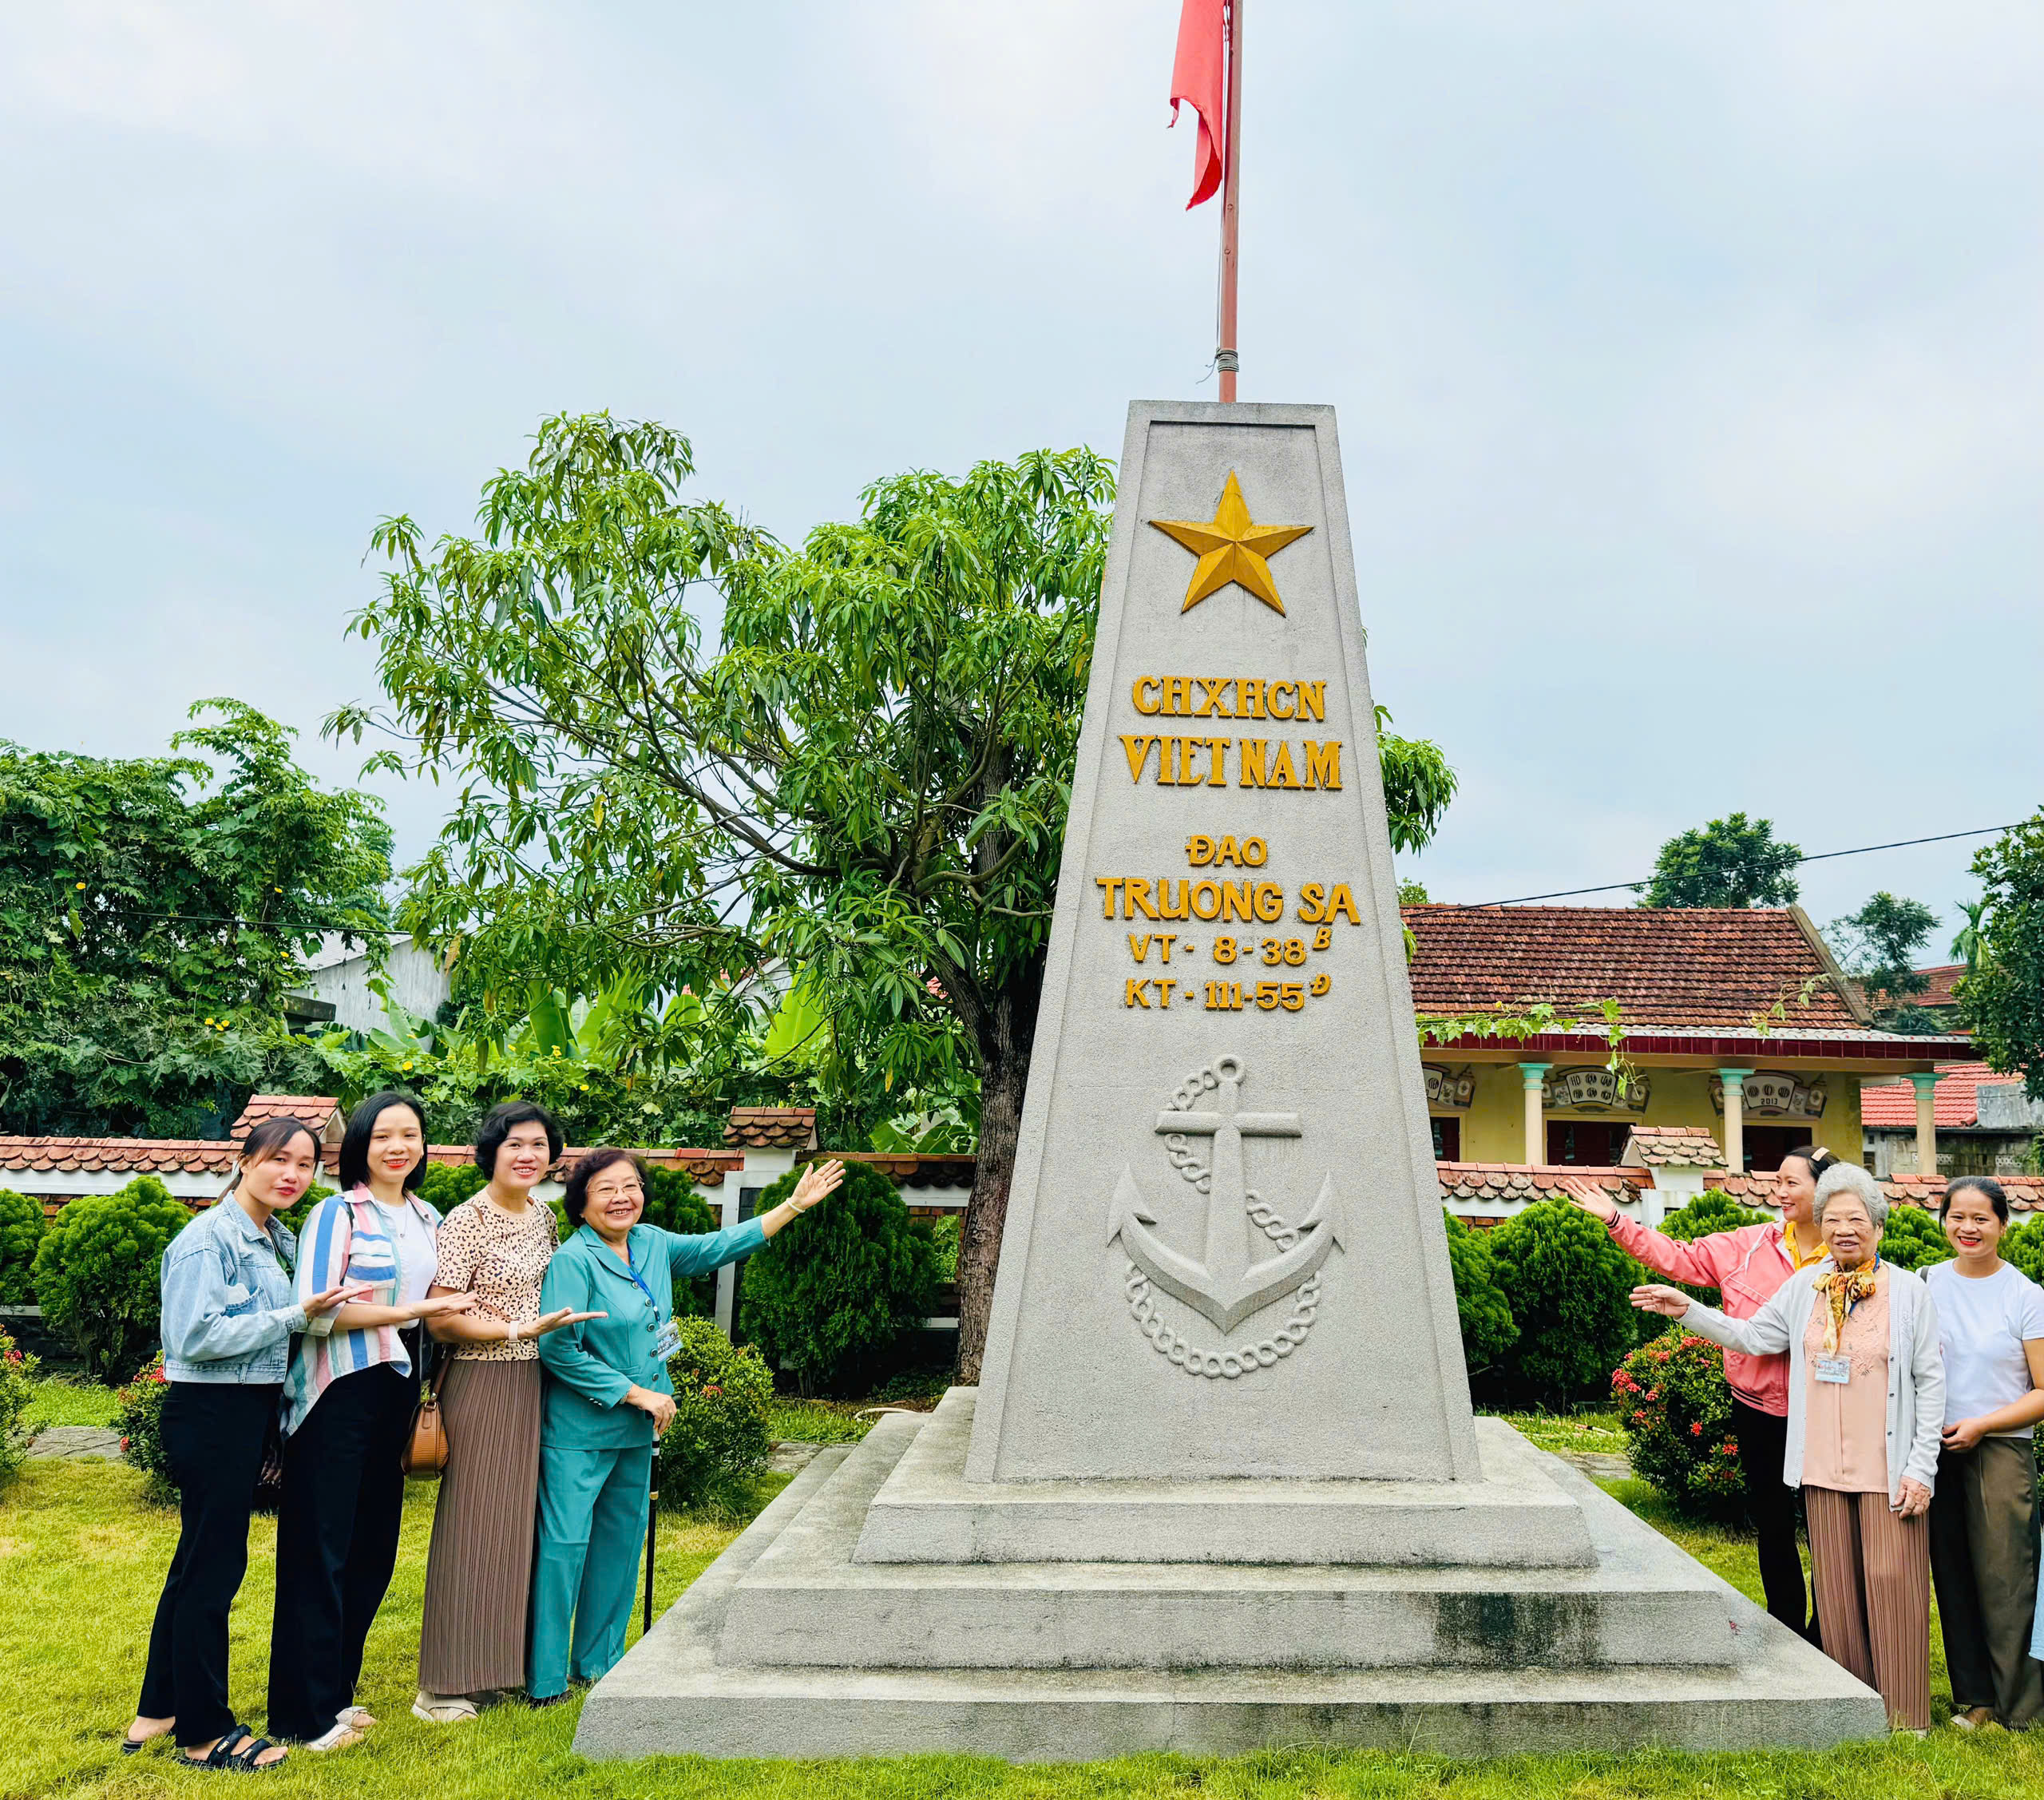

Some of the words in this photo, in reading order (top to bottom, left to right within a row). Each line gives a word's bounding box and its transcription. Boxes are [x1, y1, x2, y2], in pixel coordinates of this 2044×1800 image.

[1132, 676, 1327, 721] CHXHCN
[1119, 734, 1231, 787] VIET
[1238, 738, 1343, 790] NAM
[1095, 878, 1284, 922] TRUONG
[1297, 882, 1361, 926] SA
